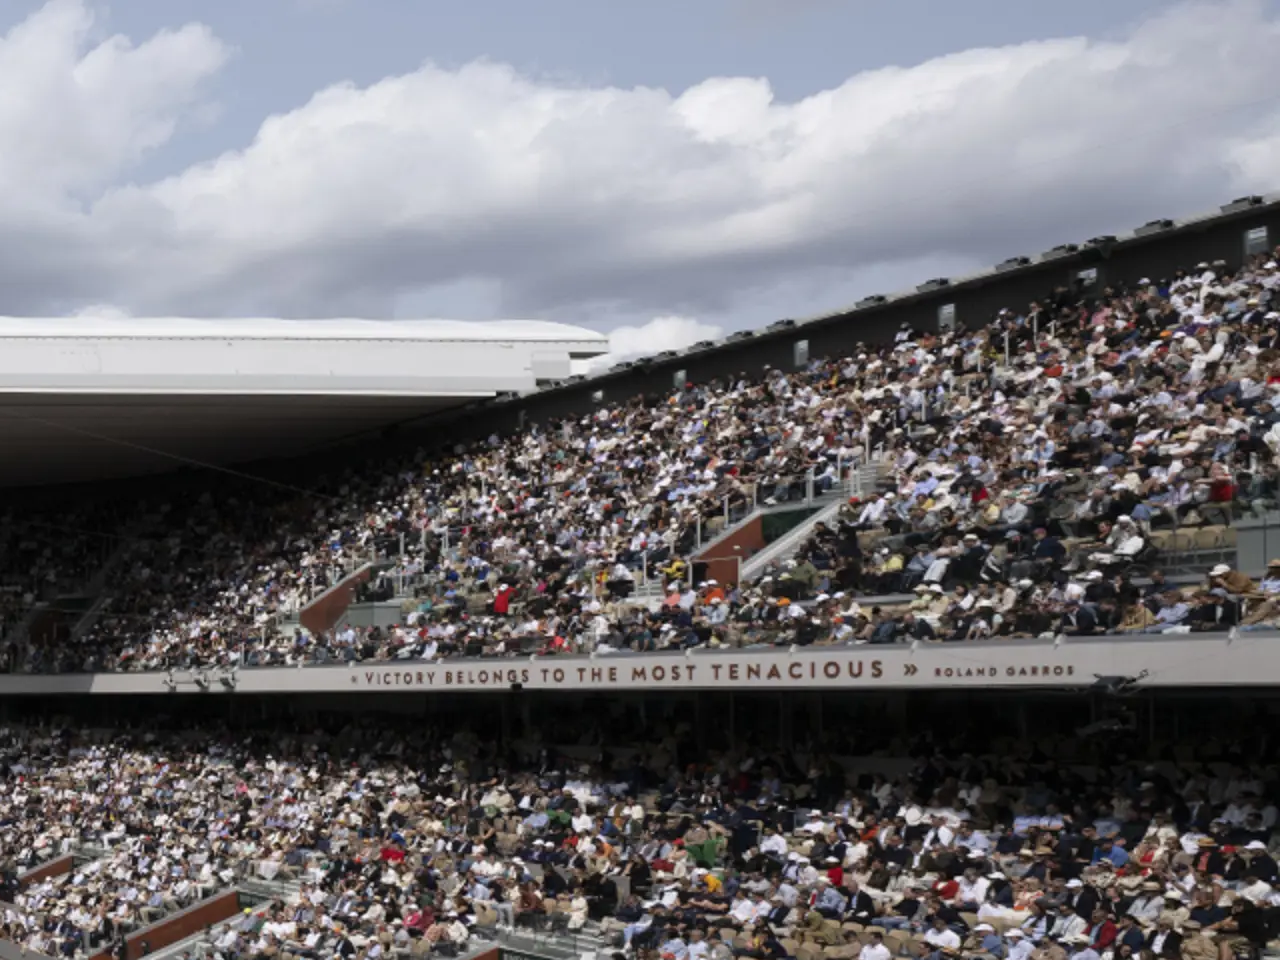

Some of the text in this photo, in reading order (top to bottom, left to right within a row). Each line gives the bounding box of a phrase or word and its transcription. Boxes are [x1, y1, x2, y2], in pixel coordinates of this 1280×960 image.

[365, 671, 436, 685] VICTORY
[445, 668, 530, 684] BELONGS
[541, 668, 566, 683] TO
[577, 666, 618, 682] THE
[631, 664, 697, 682] MOST
[711, 660, 884, 681] TENACIOUS
[934, 666, 998, 678] ROLAND
[1006, 665, 1076, 677] GARROS
